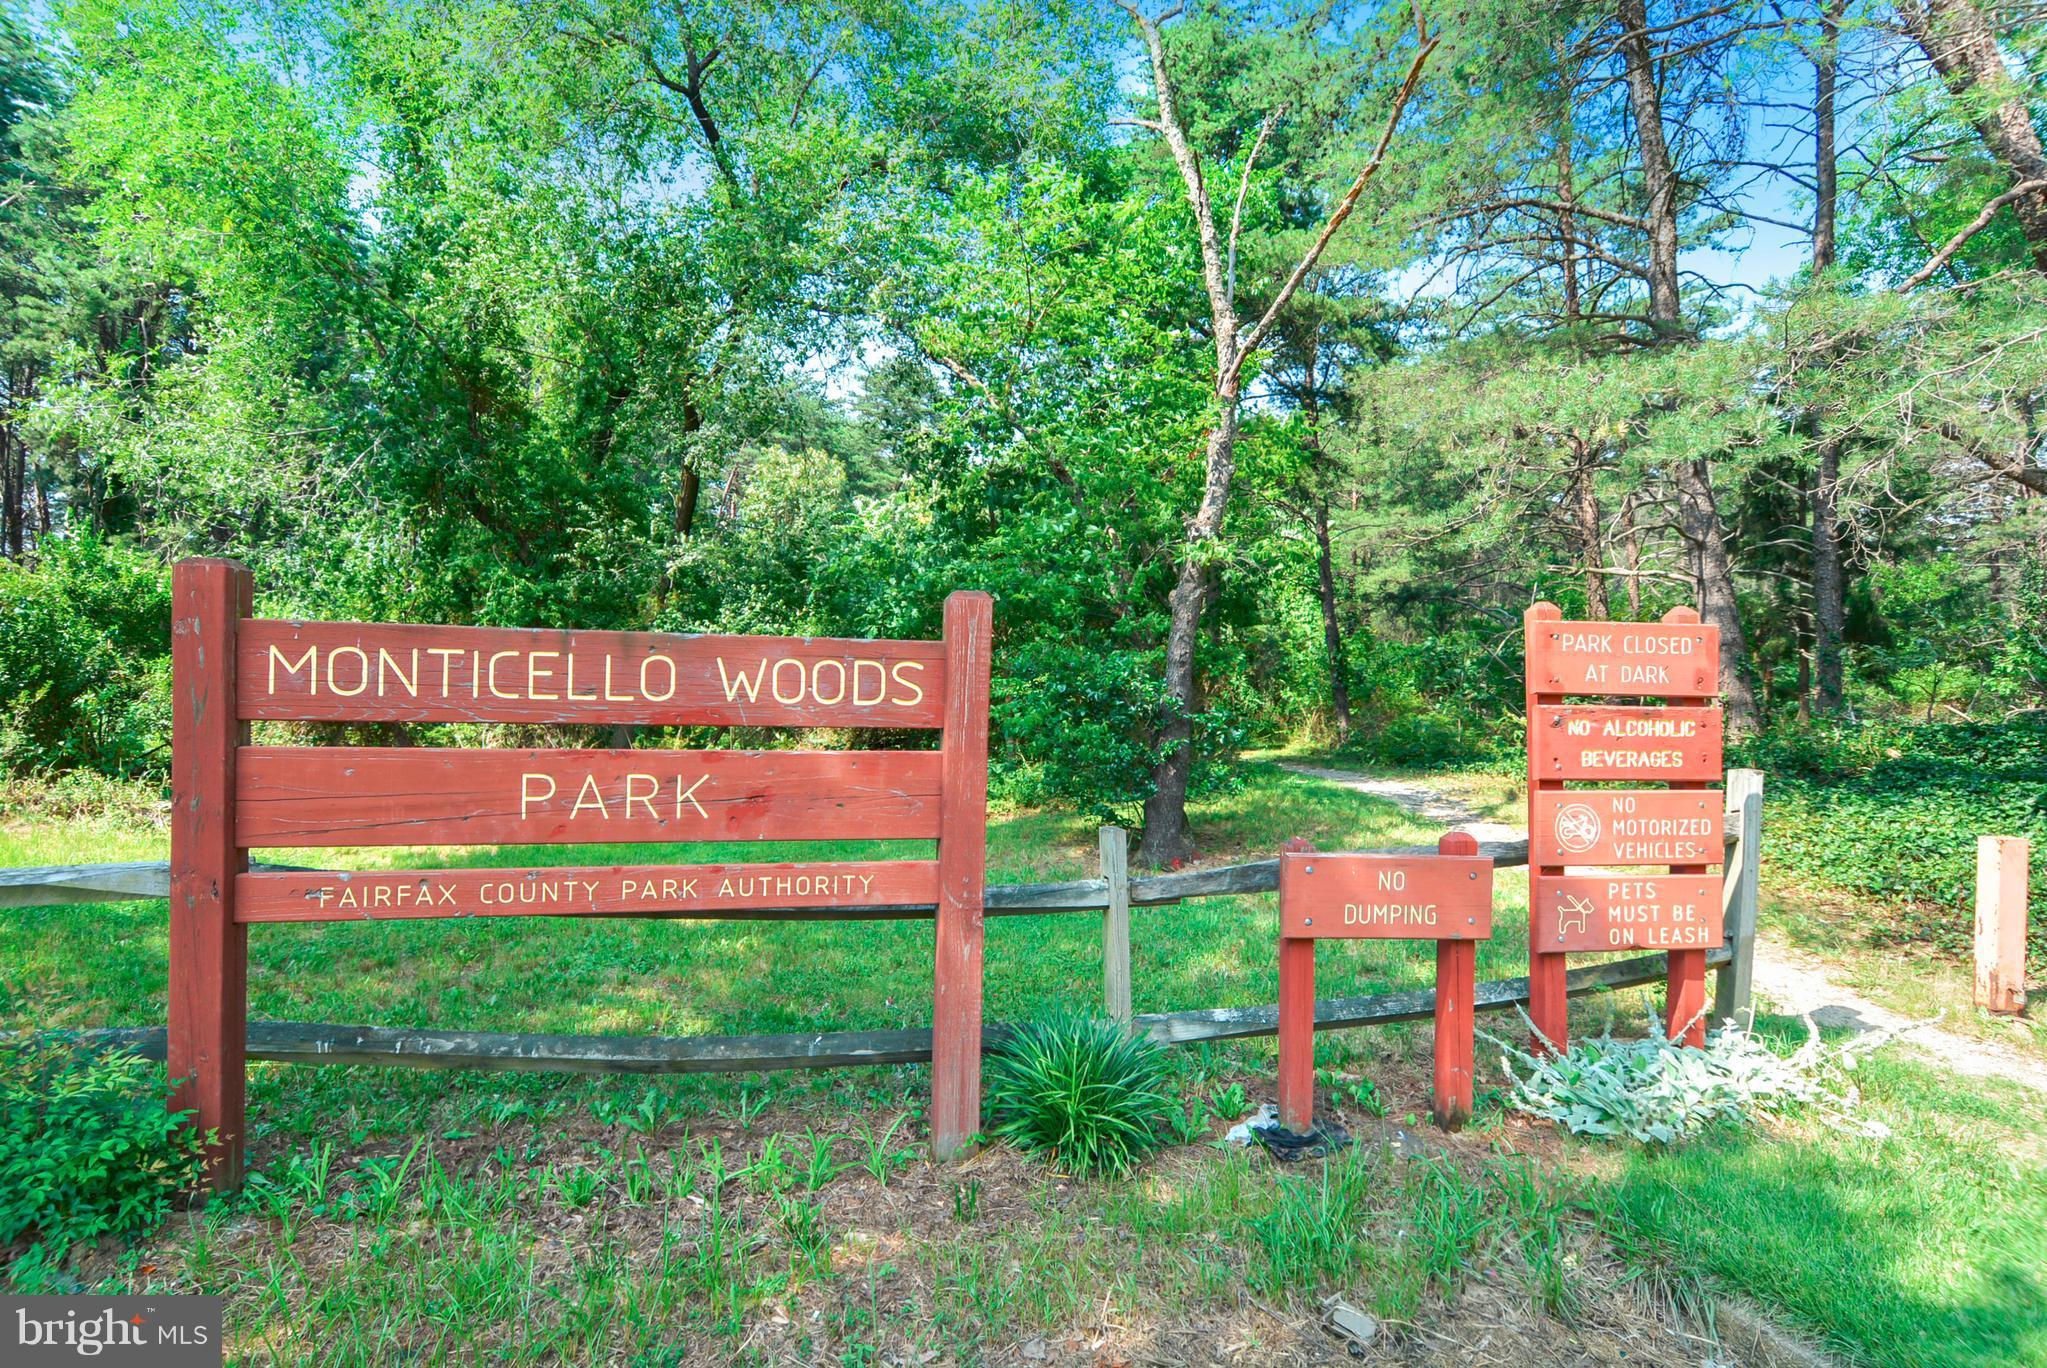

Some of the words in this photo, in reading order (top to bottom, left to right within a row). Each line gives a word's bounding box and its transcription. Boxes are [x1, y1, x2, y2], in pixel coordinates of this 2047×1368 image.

[1562, 634, 1612, 653] PARK
[1623, 636, 1692, 655] CLOSED
[267, 644, 676, 702] MONTICELLO
[717, 656, 924, 706] WOODS
[1585, 665, 1608, 682] AT
[1621, 665, 1670, 684] DARK
[1567, 720, 1590, 736] NO
[1603, 720, 1696, 738] ALCOHOLIC
[1581, 750, 1683, 768] BEVERAGES
[521, 773, 710, 821] PARK
[1612, 797, 1636, 814] NO
[1613, 819, 1711, 837] MOTORIZED
[1614, 842, 1696, 859] VEHICLES
[1378, 871, 1405, 891] NO
[319, 883, 457, 909] FAIRFAX
[480, 880, 600, 906] COUNTY
[621, 878, 698, 901] PARK
[718, 874, 875, 898] AUTHORITY
[1608, 882, 1656, 900] PETS
[1344, 904, 1437, 925] DUMPING
[1608, 905, 1660, 922] MUST
[1673, 904, 1695, 922] BE
[1610, 928, 1634, 945] ON
[1648, 926, 1709, 945] LEASH
